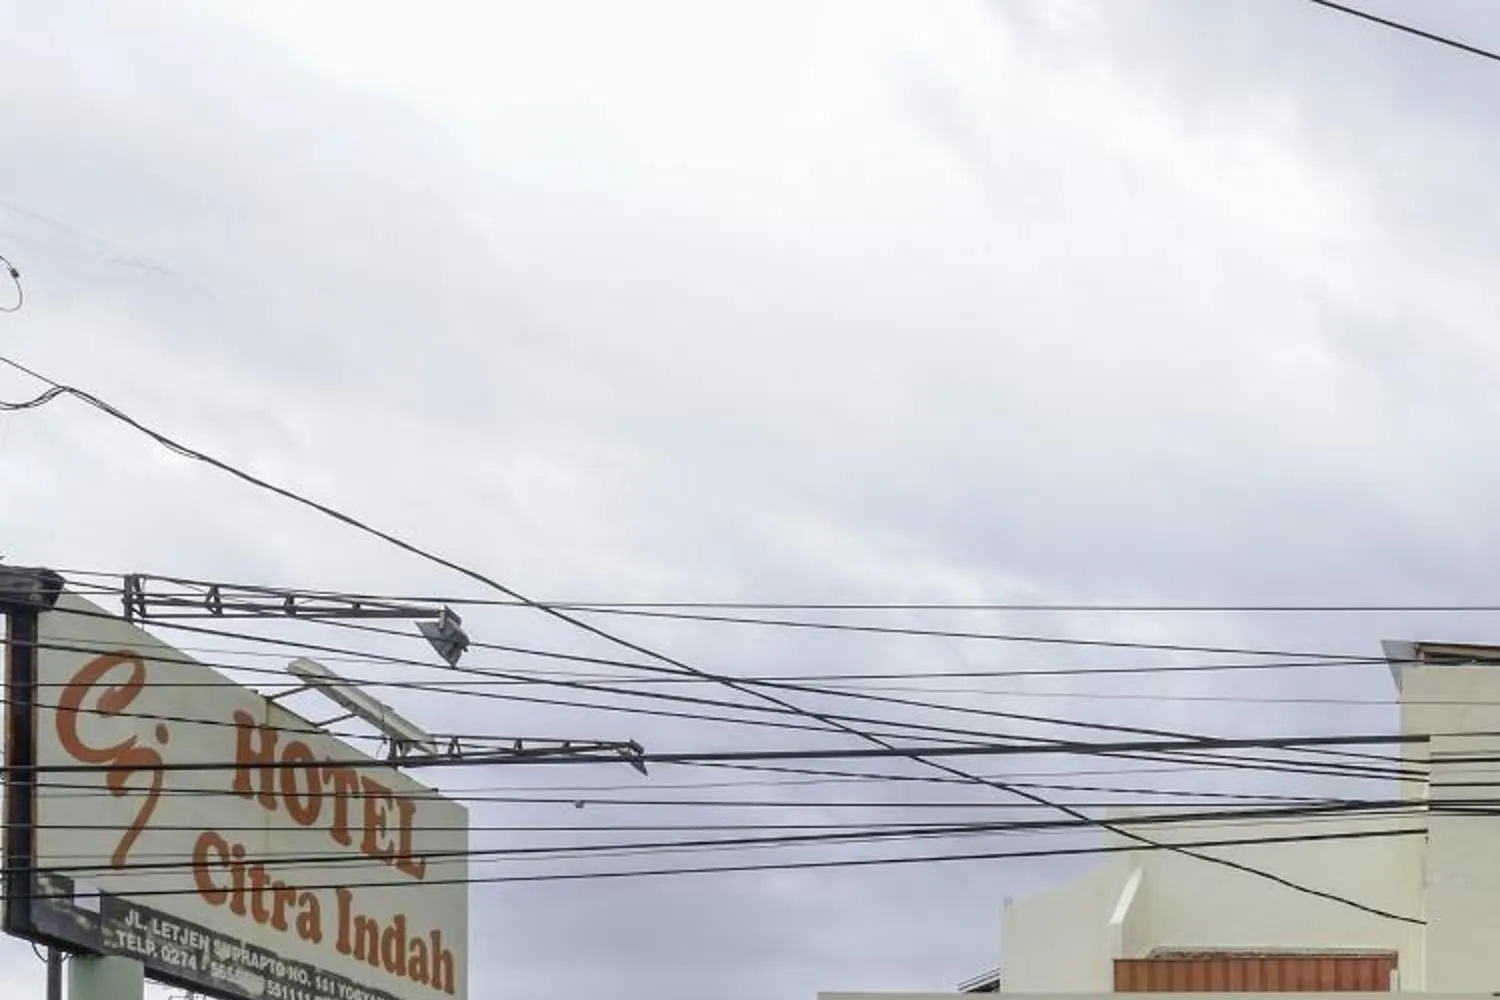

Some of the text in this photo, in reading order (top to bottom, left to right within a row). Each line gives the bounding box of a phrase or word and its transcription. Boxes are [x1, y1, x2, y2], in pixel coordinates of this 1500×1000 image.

[233, 709, 427, 880] HOTEL
[124, 907, 147, 932] JL.
[153, 916, 210, 953] LETJEN
[161, 943, 197, 971] 0274
[193, 832, 455, 996] Citra Indah
